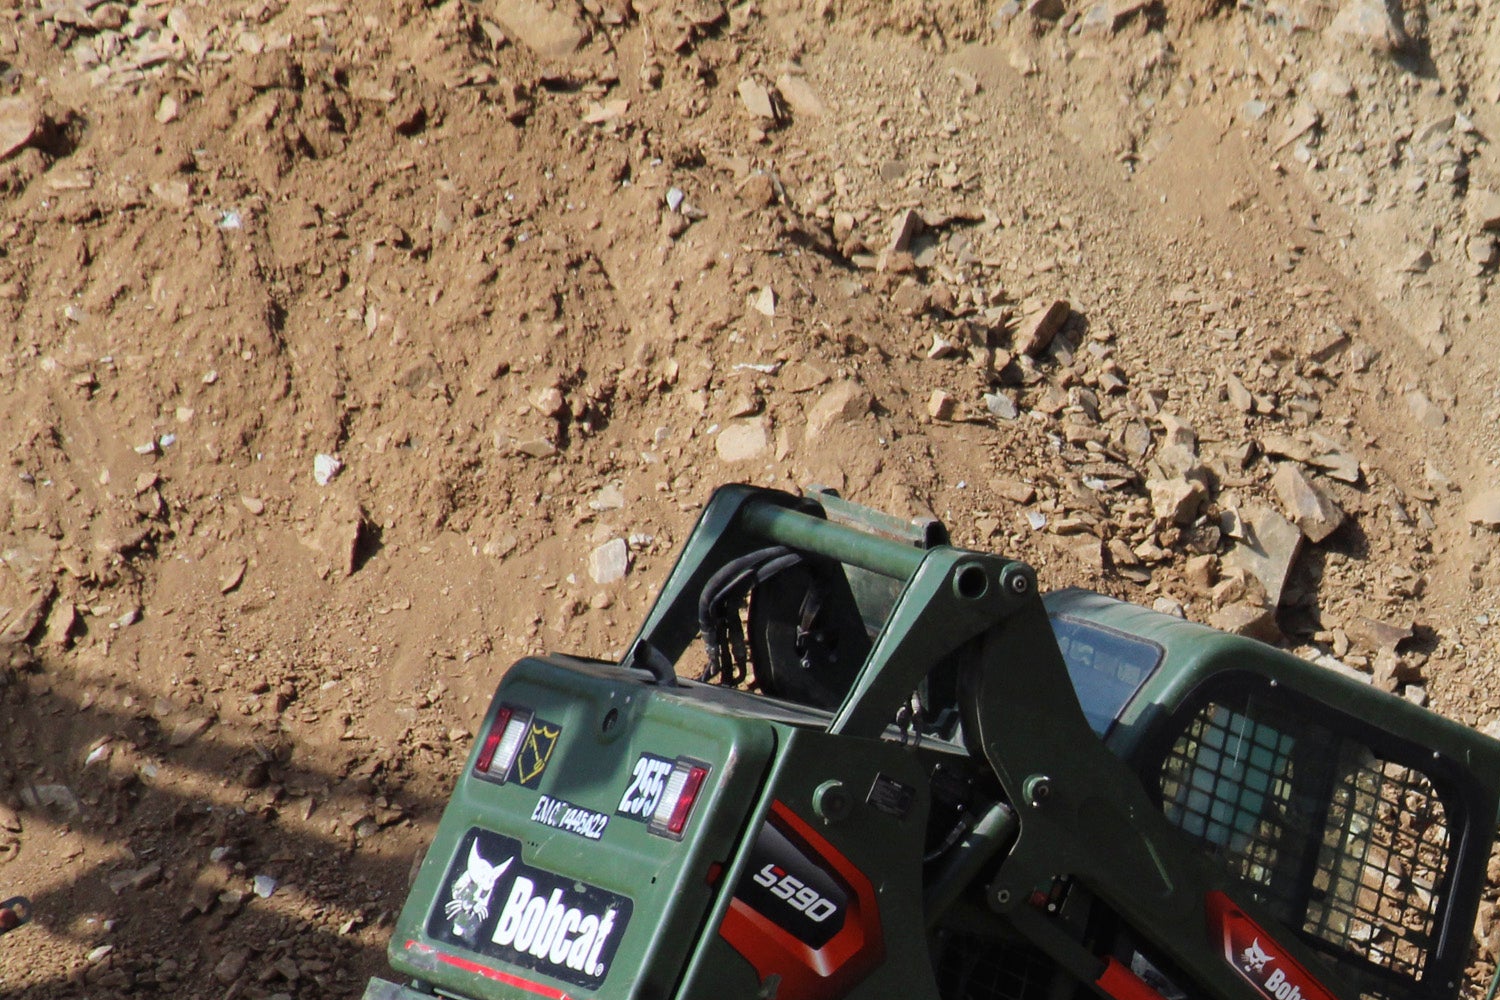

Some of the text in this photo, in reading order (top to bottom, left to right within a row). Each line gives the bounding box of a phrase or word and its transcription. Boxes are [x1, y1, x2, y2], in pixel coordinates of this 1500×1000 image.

[618, 756, 672, 818] 255
[753, 863, 837, 923] S590
[491, 875, 617, 976] Bobcat
